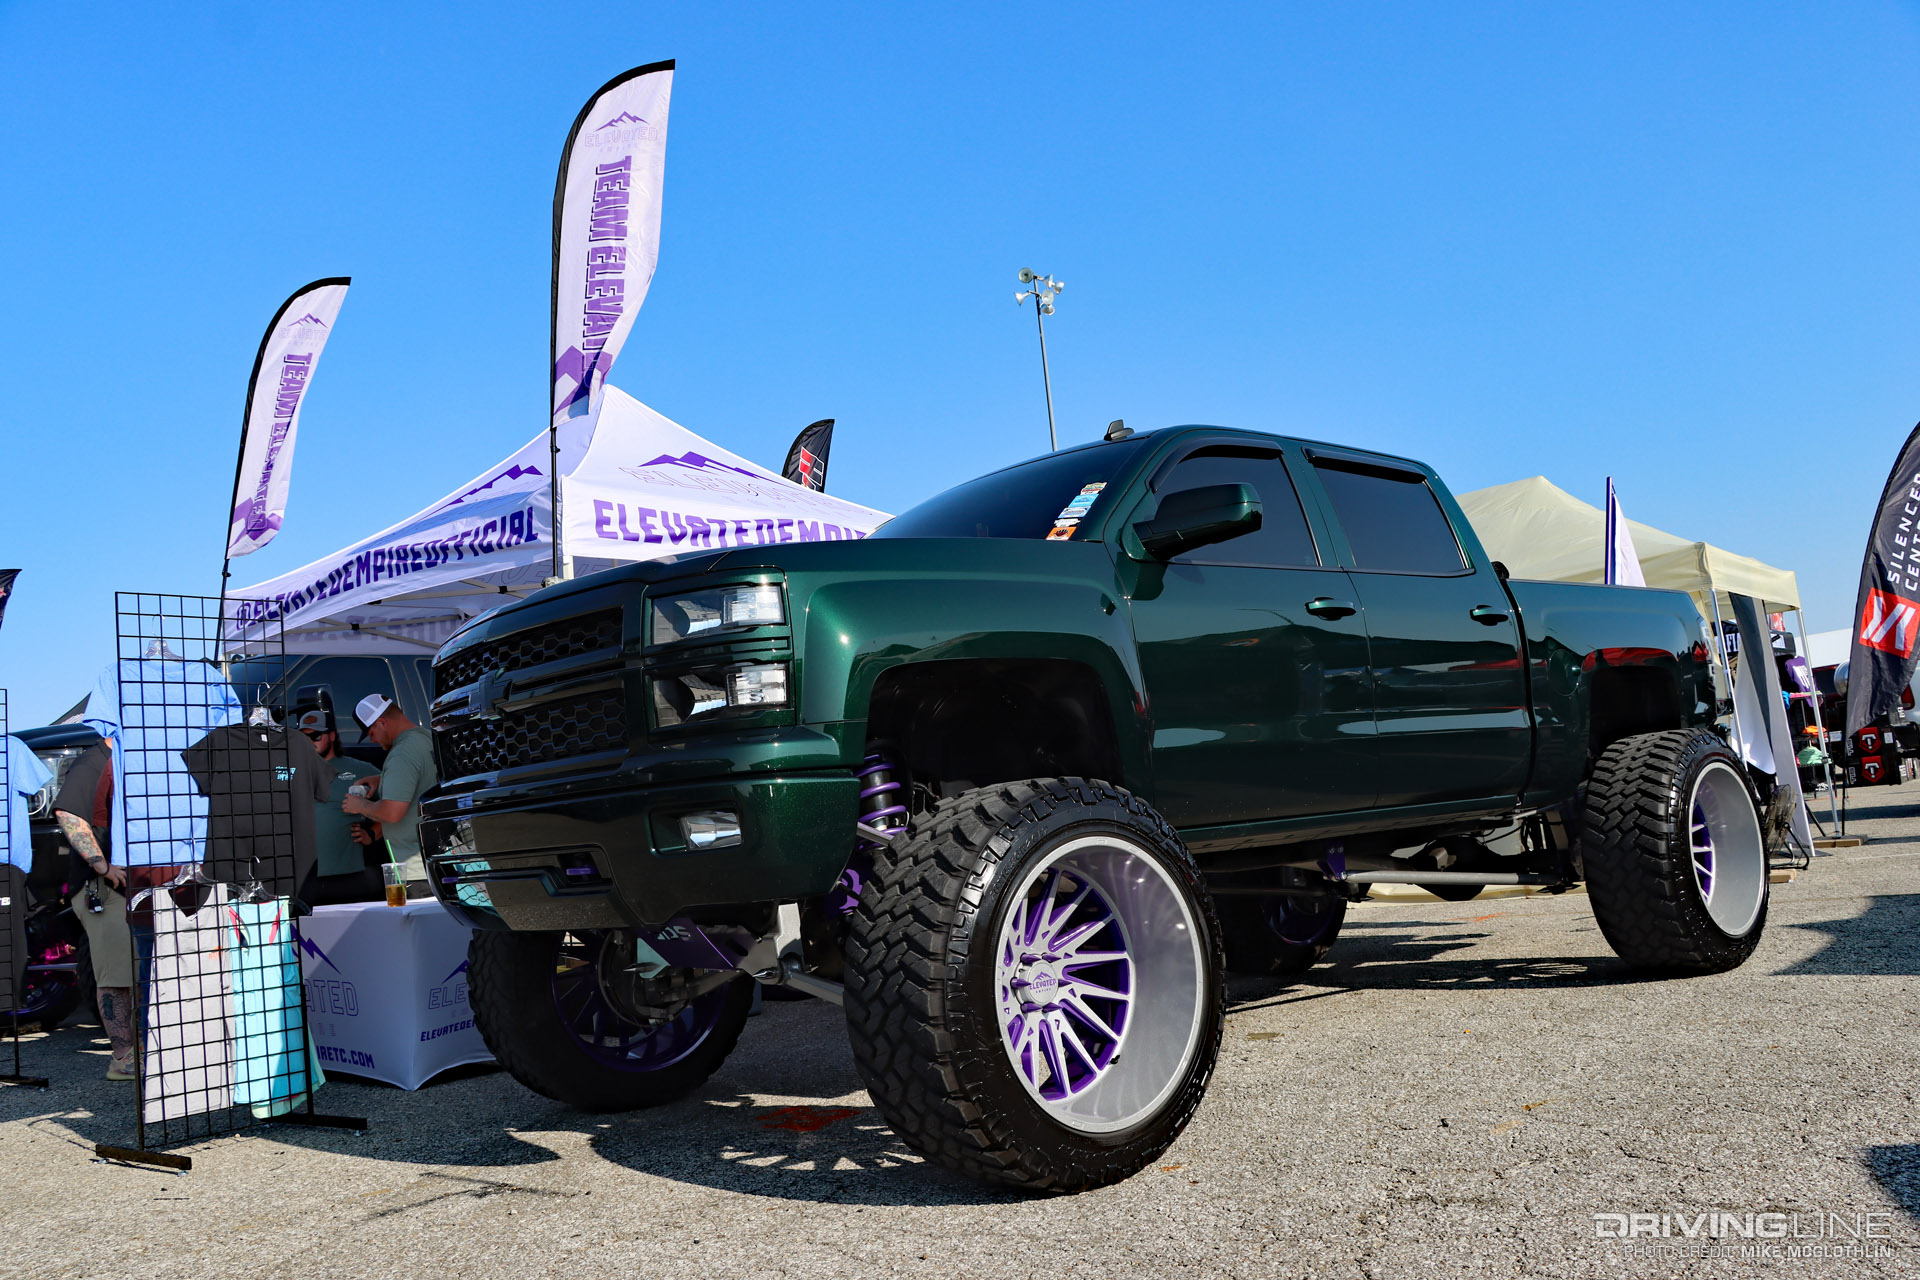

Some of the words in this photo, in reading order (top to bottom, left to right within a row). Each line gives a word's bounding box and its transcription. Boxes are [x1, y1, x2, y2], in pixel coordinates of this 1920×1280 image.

[588, 155, 632, 242] TEAM
[582, 246, 626, 388] ELEVA
[273, 352, 313, 419] TEAM
[1905, 518, 1920, 592] CENT
[304, 979, 359, 1016] ATED
[316, 1045, 375, 1069] IRETC.COM
